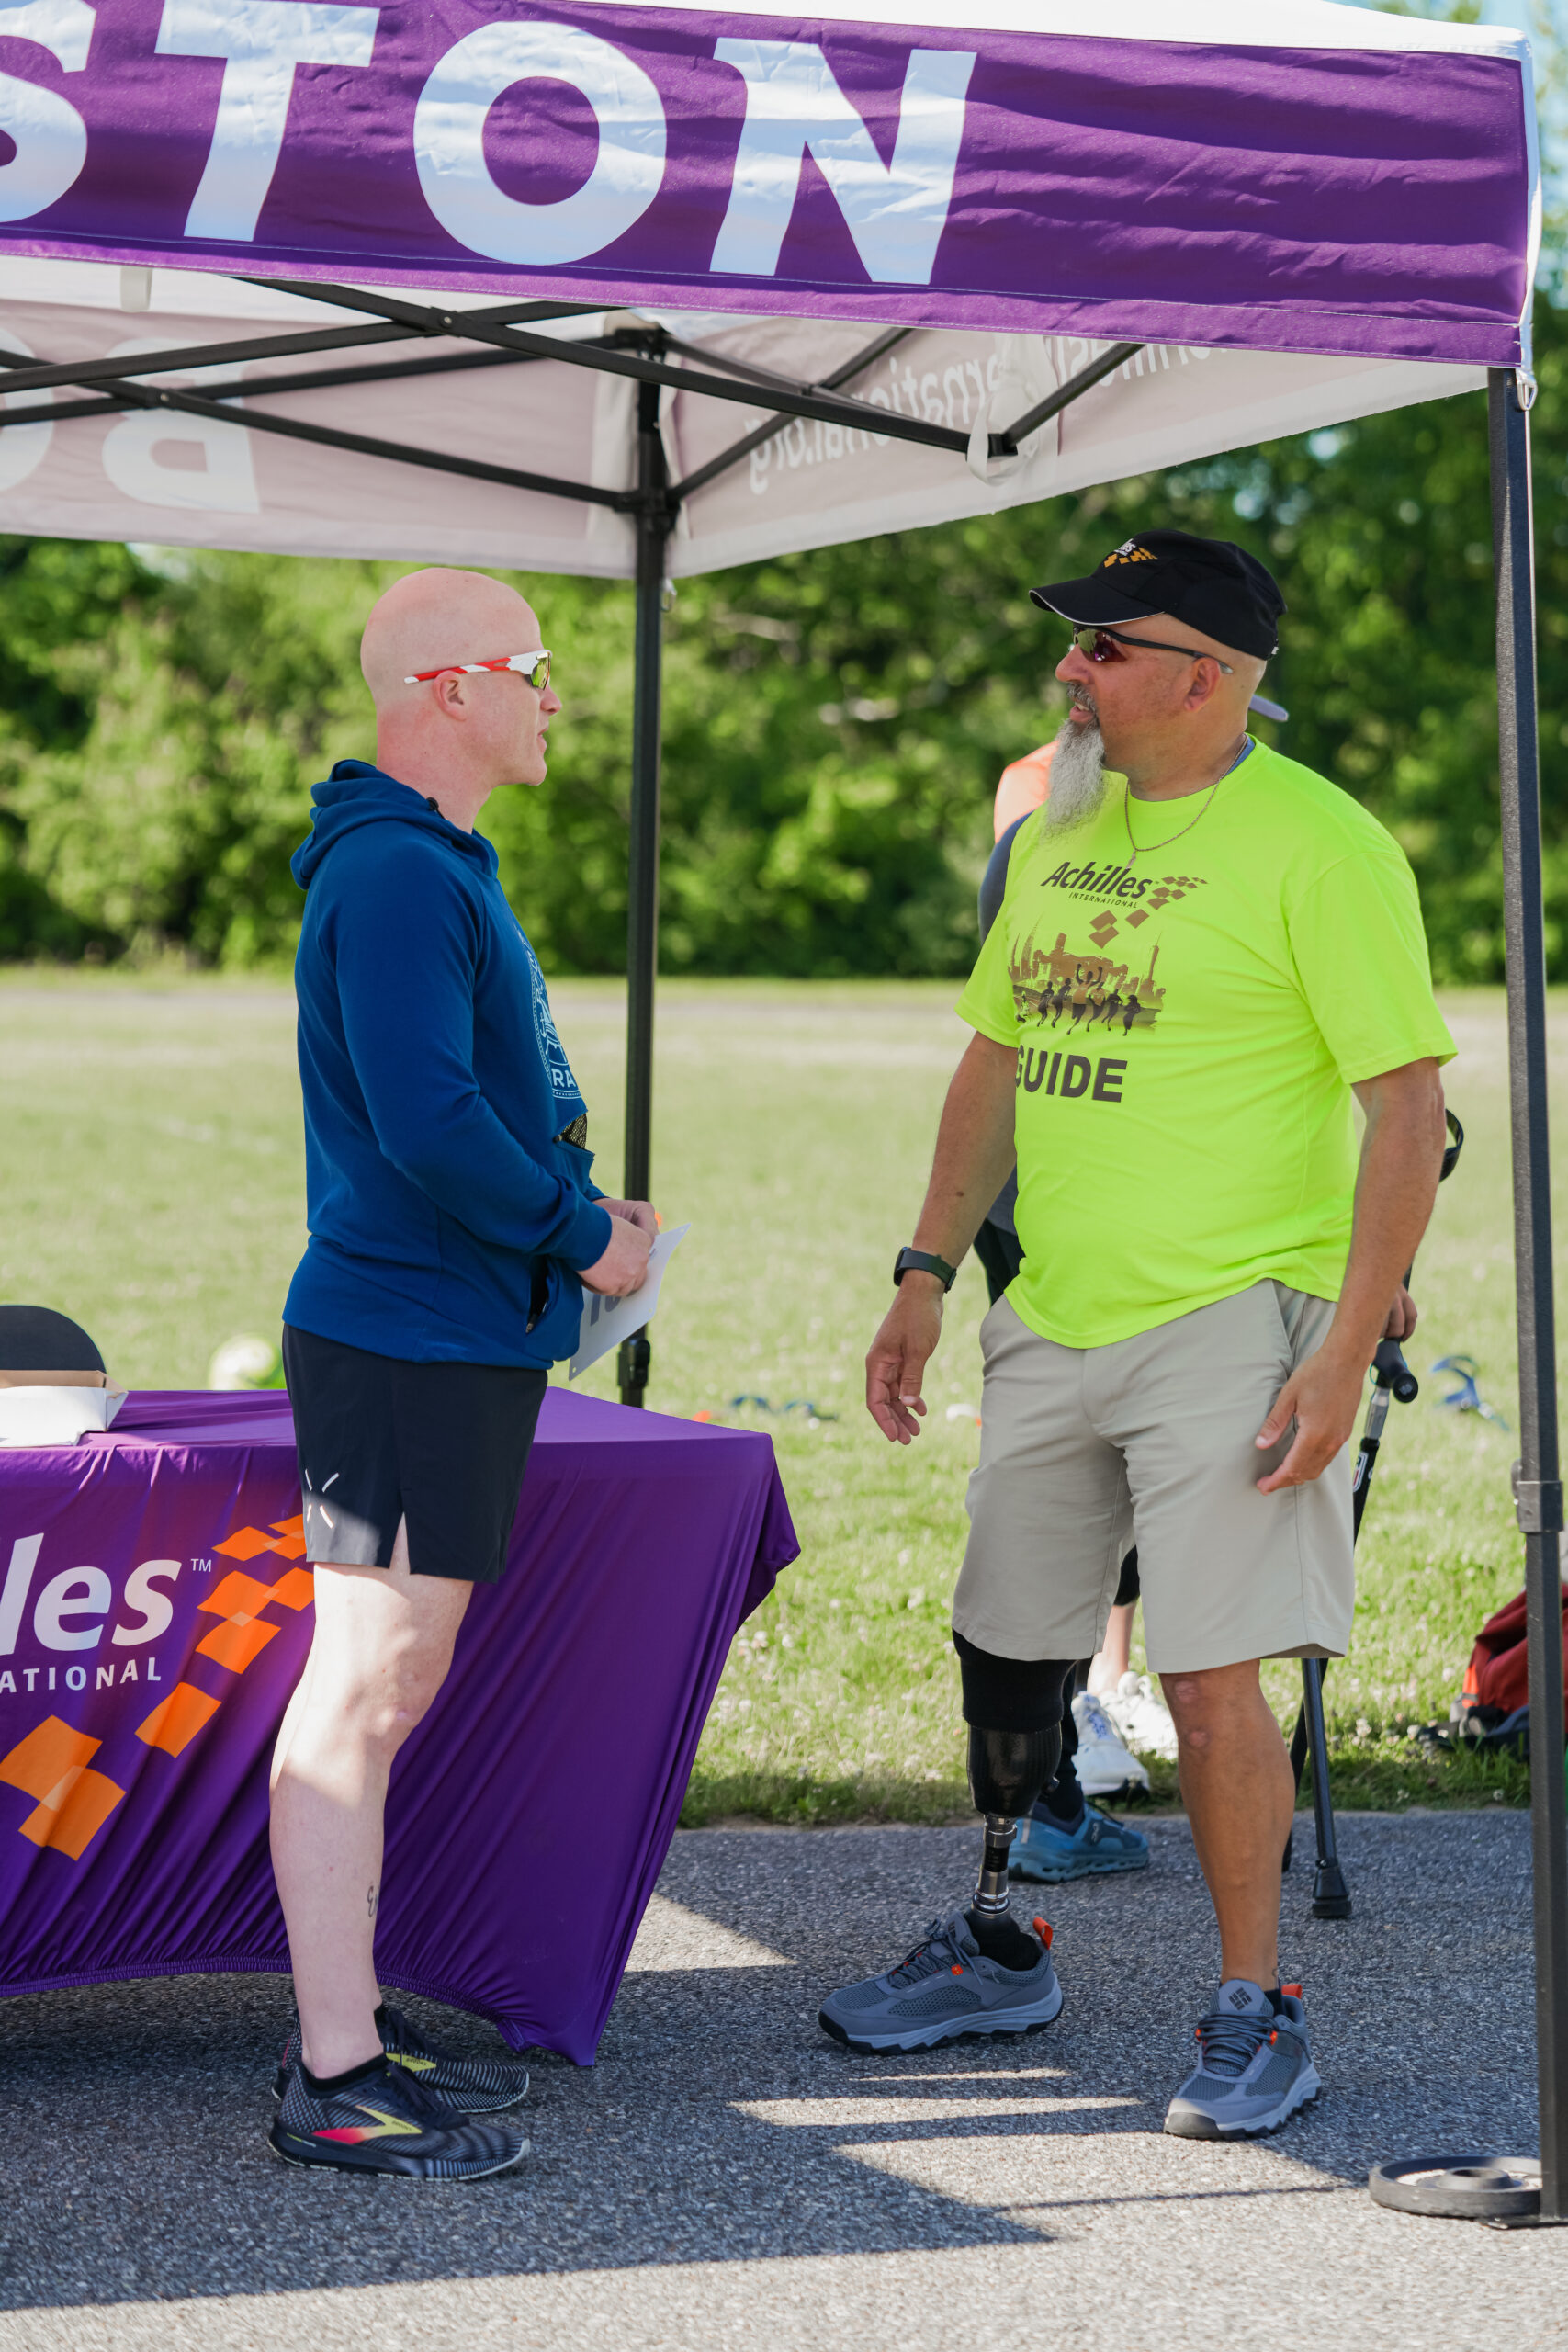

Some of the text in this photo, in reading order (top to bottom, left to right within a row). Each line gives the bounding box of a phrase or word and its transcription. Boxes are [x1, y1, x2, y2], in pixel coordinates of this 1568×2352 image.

[1040, 861, 1154, 899] Achilles
[1068, 891, 1139, 910] INTERNATIONAL
[1014, 1043, 1128, 1103] GUIDE
[0, 1532, 183, 1656] les
[0, 1657, 162, 1694] ATIONAL
